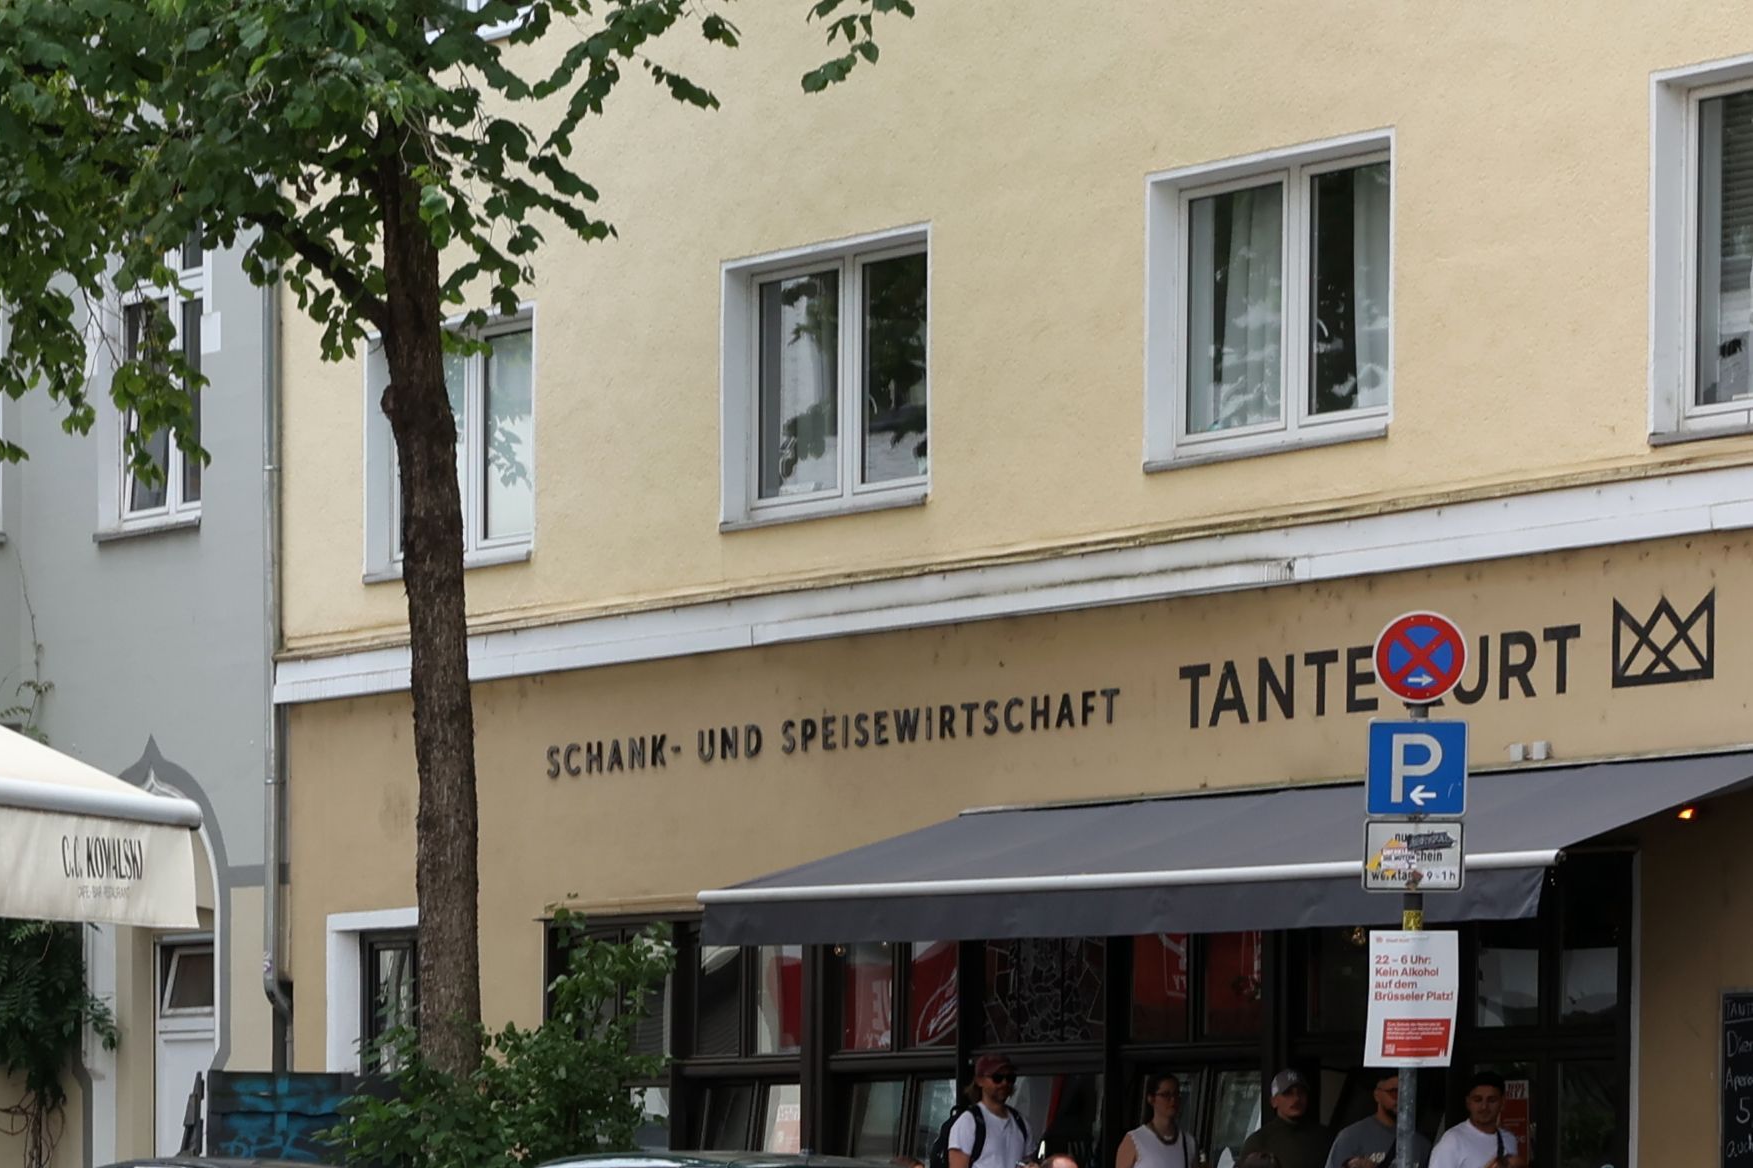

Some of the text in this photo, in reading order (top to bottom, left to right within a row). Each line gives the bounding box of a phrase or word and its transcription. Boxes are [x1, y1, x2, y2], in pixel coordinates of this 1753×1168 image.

[1179, 624, 1581, 730] TANTE URT
[545, 687, 1121, 779] SCHANK- UND SPEISEWIRTSCHAFT
[1390, 733, 1443, 804] P
[86, 836, 143, 881] KOWALSKI
[1375, 955, 1390, 965] 22
[1400, 955, 1408, 965] 6
[1410, 955, 1432, 965] Uhr:
[1375, 967, 1439, 977] Kein Alkohol
[1374, 990, 1454, 1001] Brüsseler Platz!
[1375, 979, 1418, 989] auf dem
[1725, 1068, 1753, 1093] Apero
